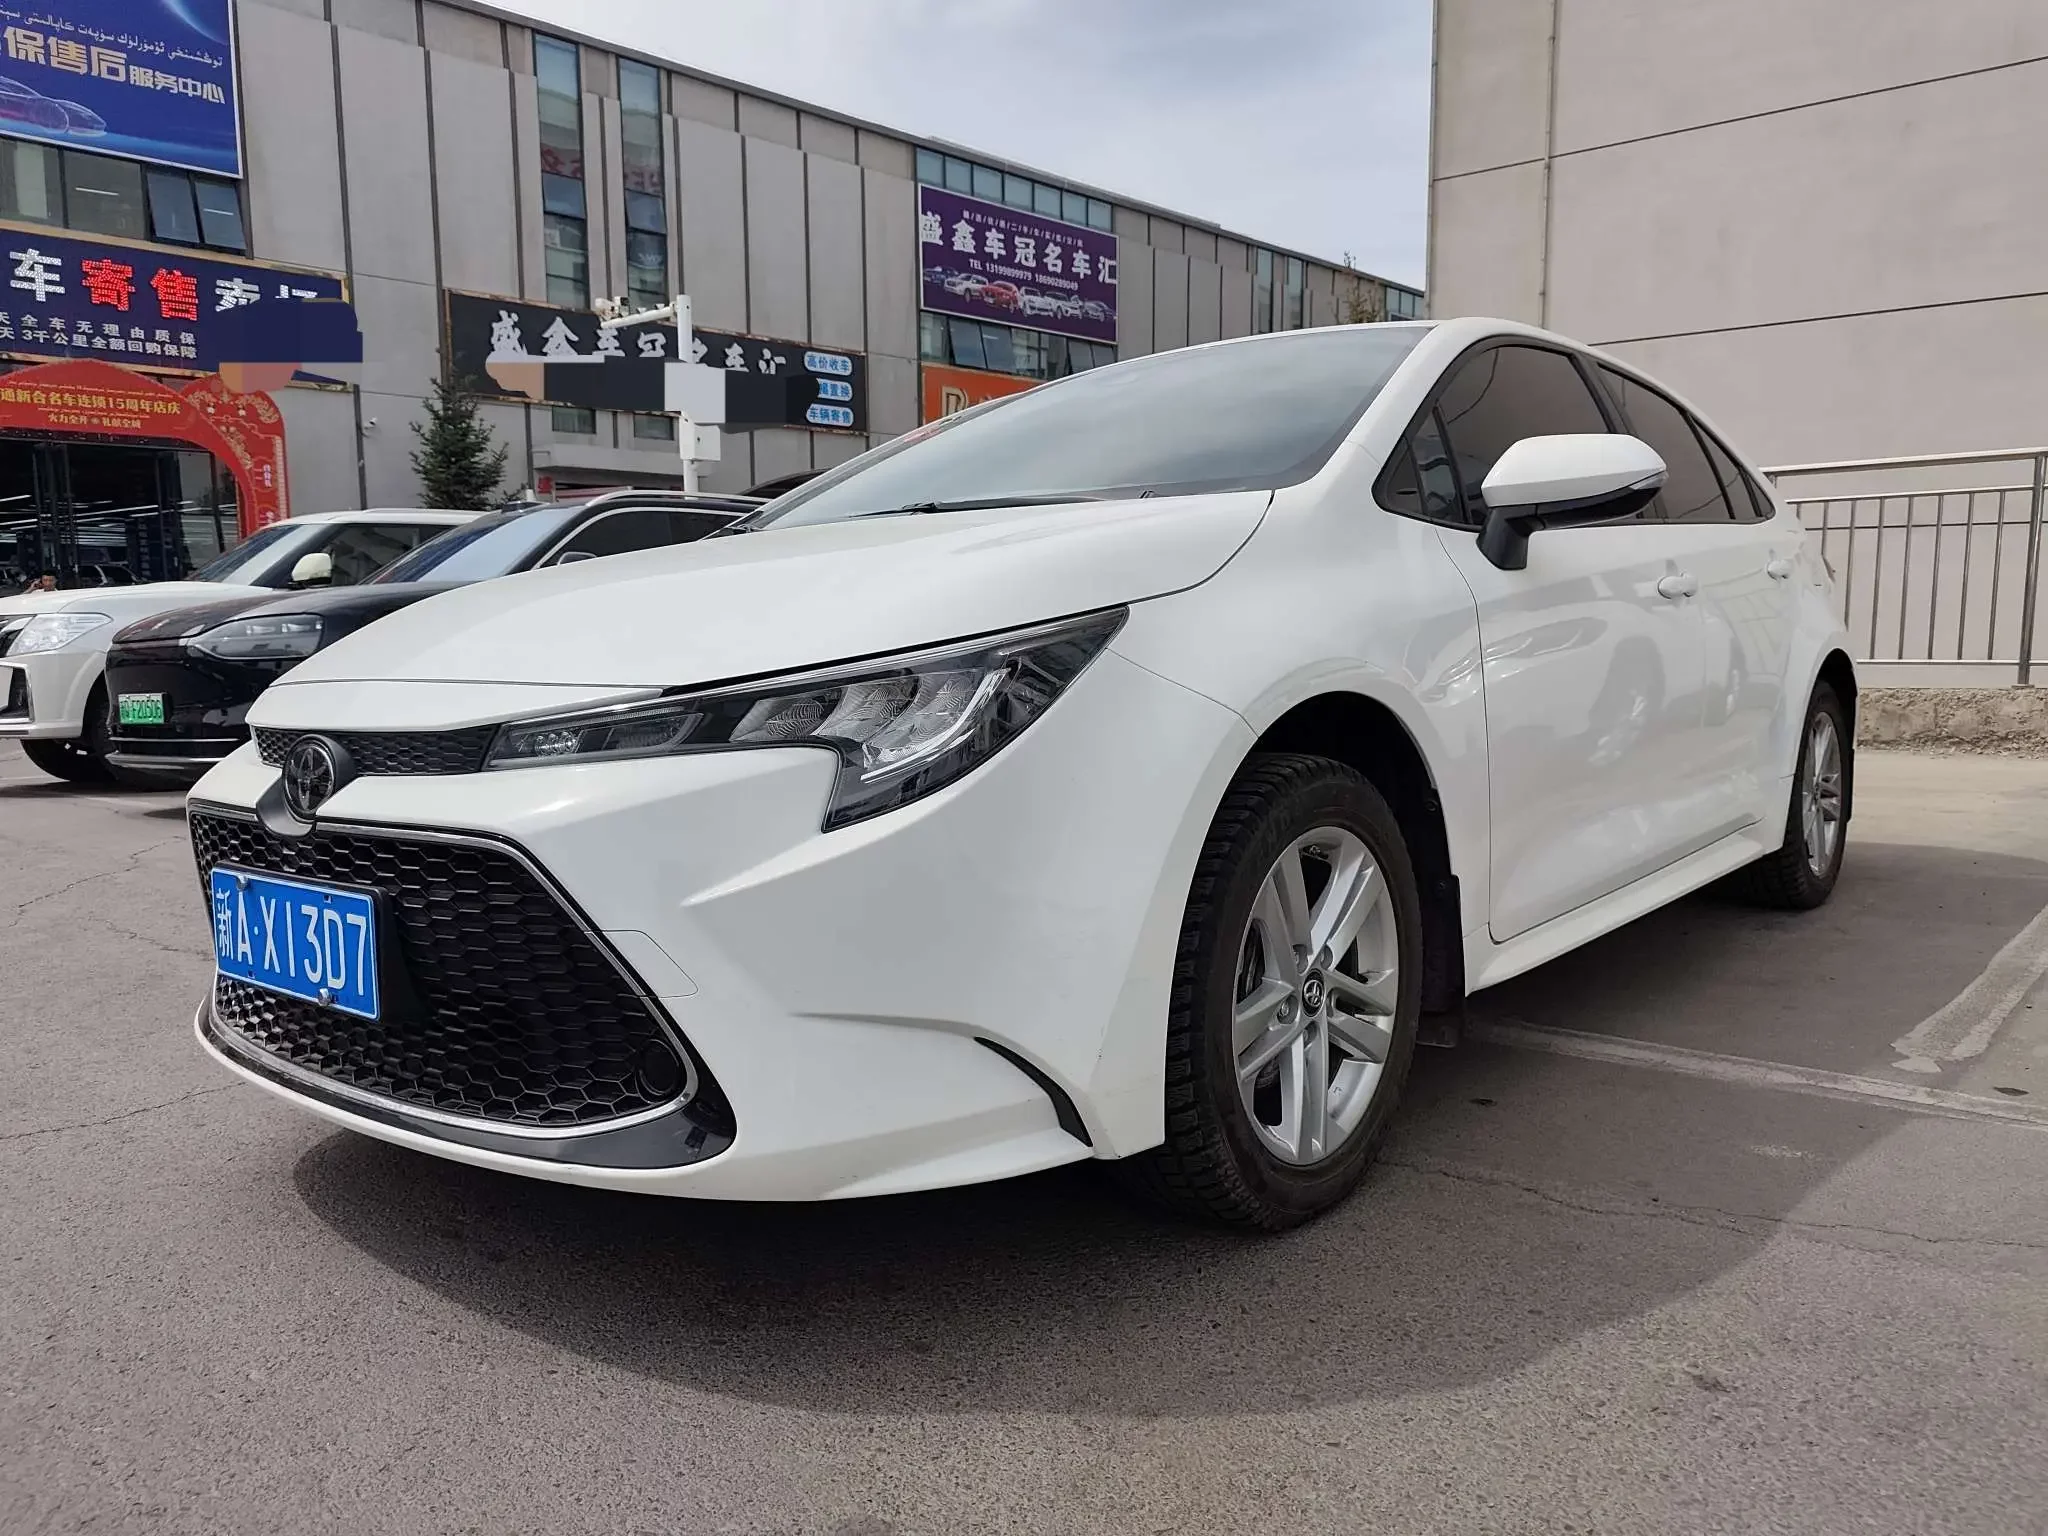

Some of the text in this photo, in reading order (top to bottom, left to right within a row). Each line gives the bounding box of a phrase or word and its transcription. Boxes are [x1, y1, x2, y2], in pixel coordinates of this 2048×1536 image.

[921, 211, 1117, 284] 盛鑫车冠名车汇
[969, 258, 983, 271] TEL
